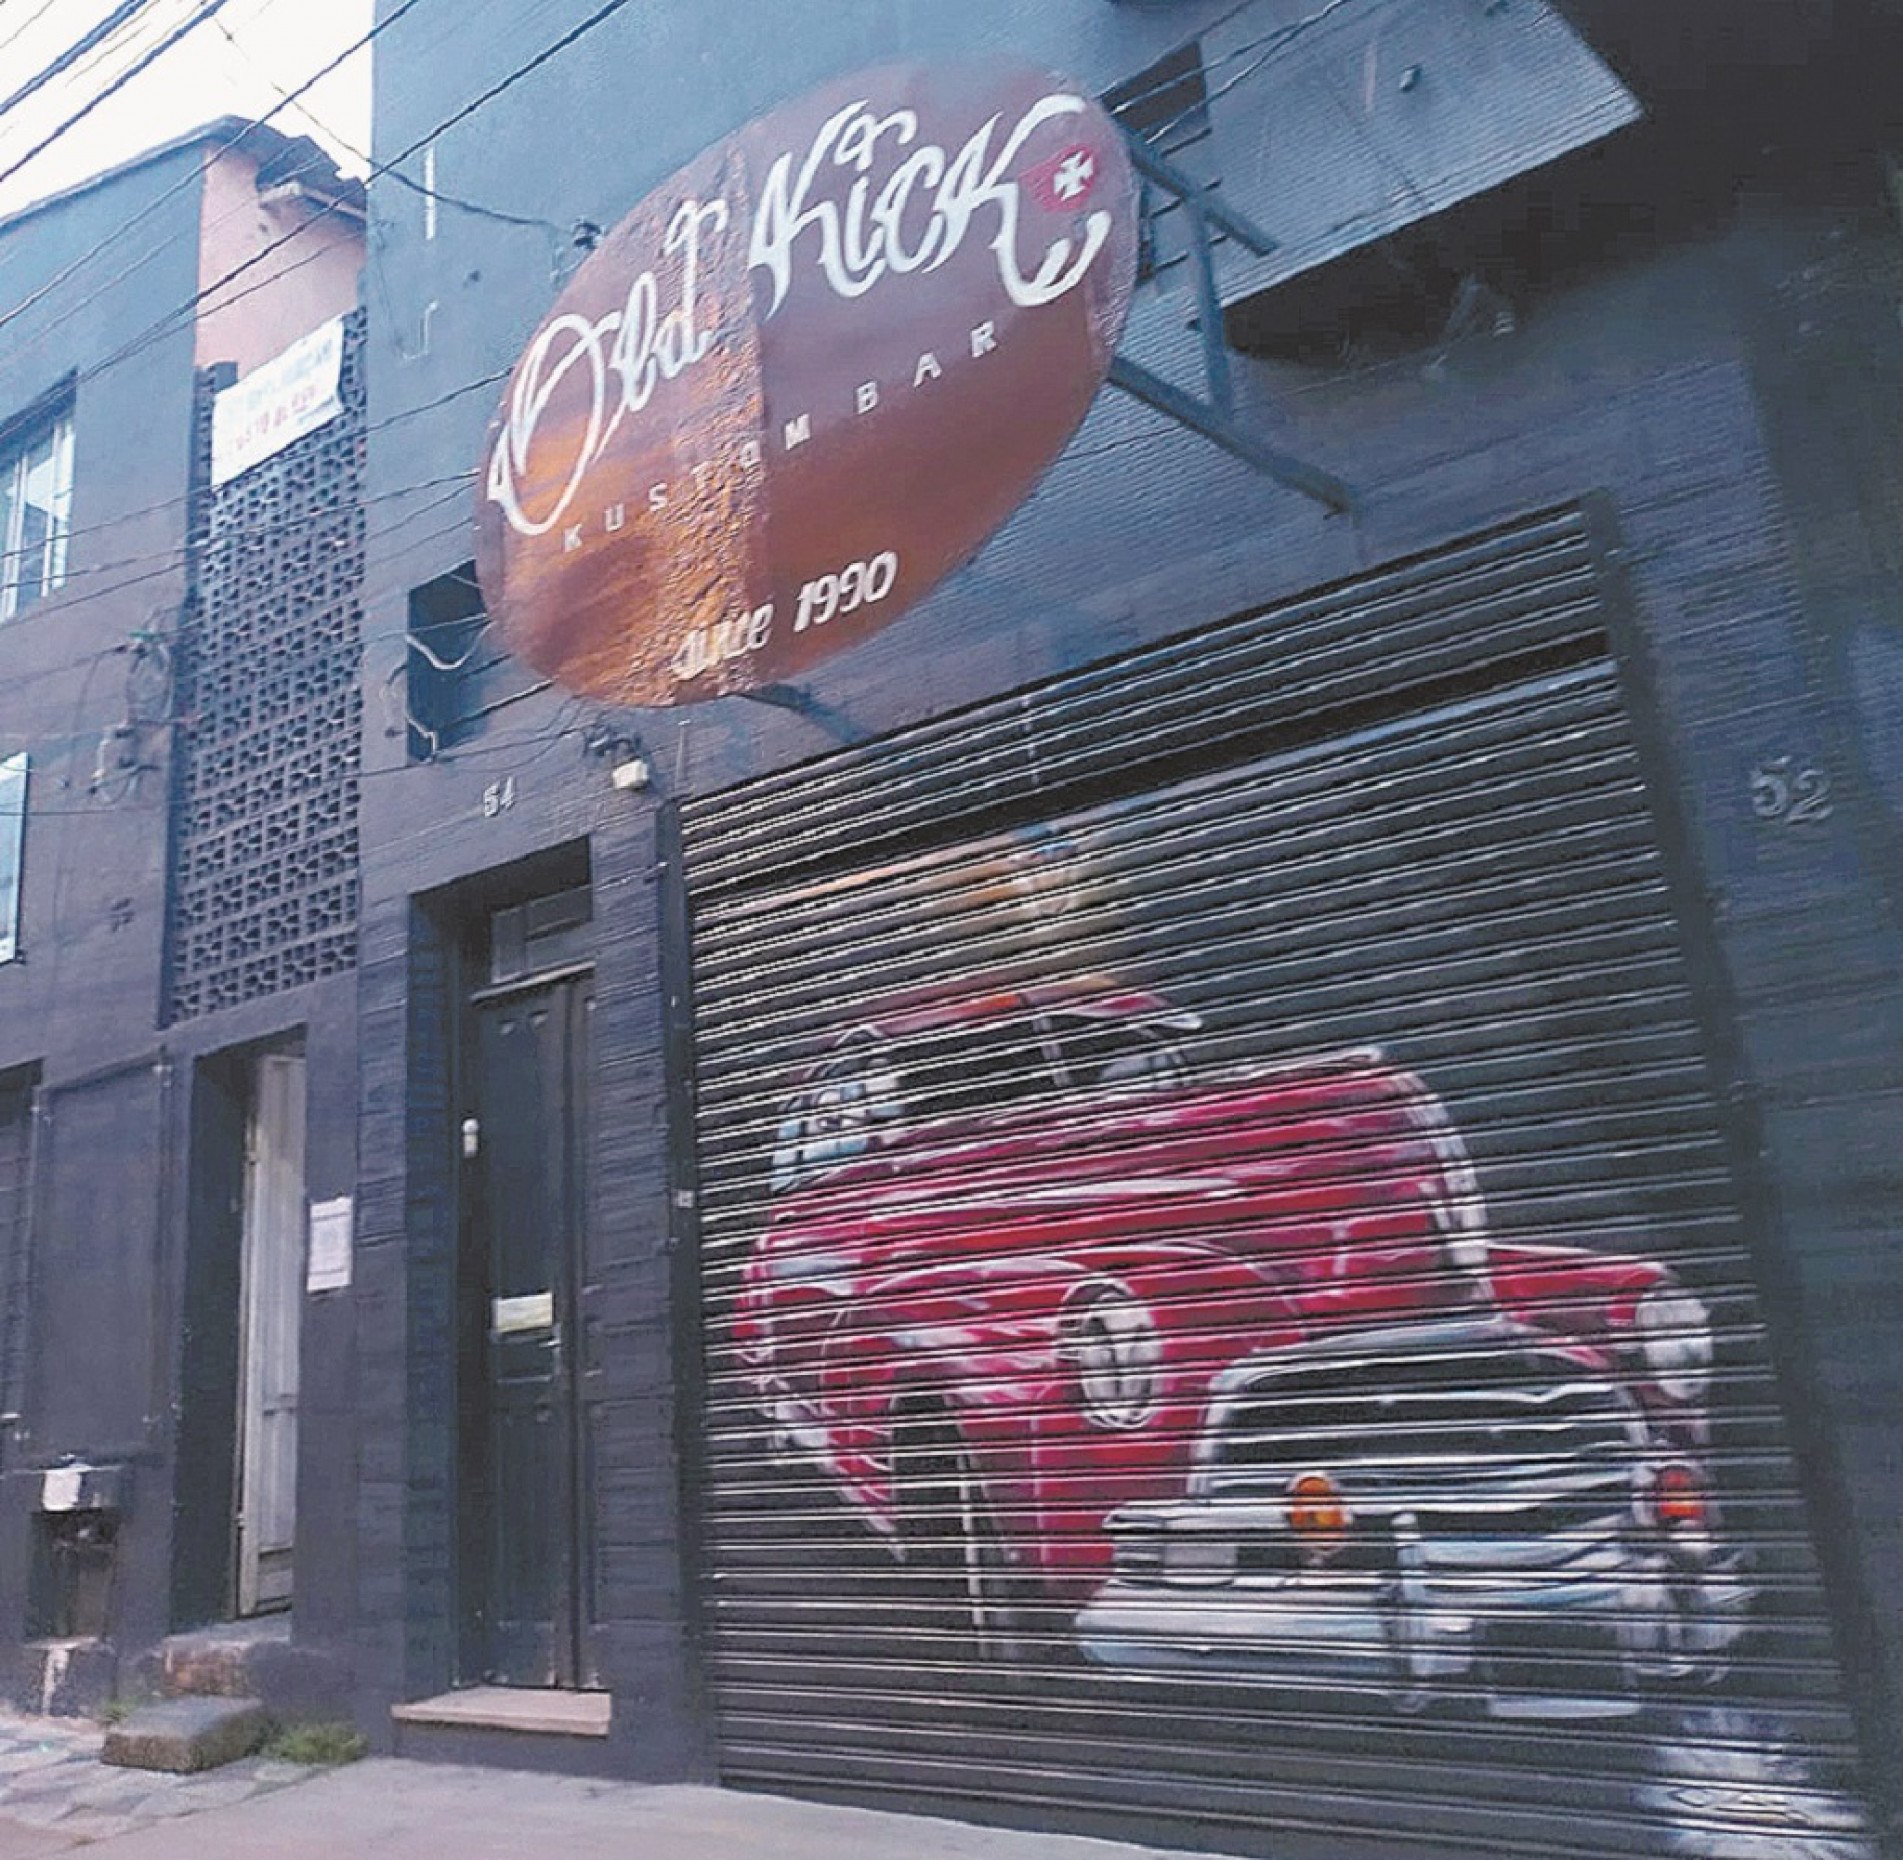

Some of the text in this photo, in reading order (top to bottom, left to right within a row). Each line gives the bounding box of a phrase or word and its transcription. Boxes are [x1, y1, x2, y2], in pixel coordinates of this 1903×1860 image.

[486, 199, 731, 535] Old
[564, 320, 997, 552] KUSTOM BAR
[794, 551, 897, 632] 1990
[1752, 756, 1834, 823] 52
